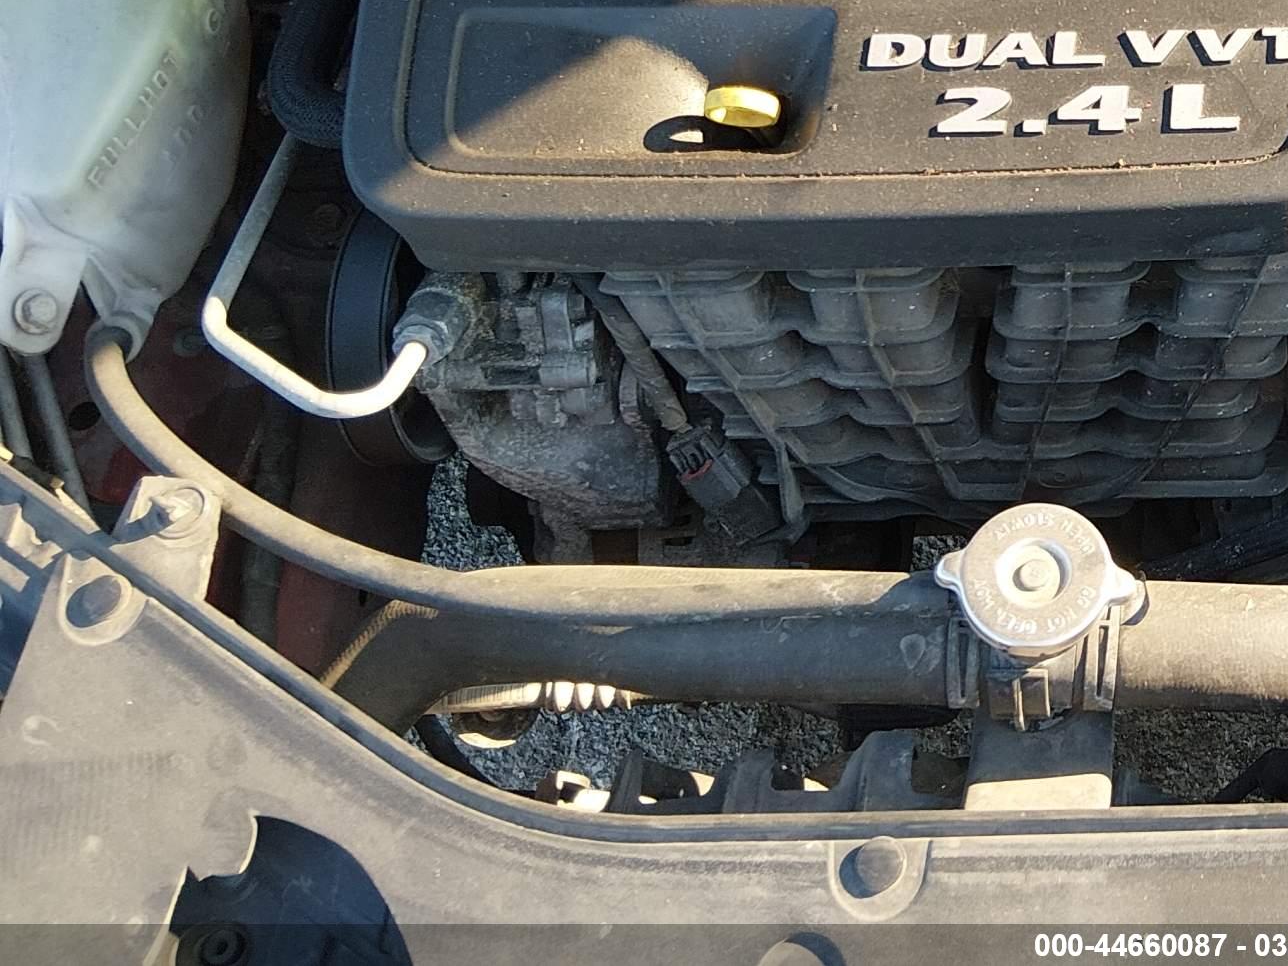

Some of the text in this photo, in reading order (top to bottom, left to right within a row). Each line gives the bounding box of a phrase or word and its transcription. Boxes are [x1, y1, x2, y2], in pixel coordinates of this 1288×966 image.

[864, 31, 1106, 69] DUAL
[935, 84, 1241, 134] 2.4 L
[1060, 520, 1096, 556] OPEN
